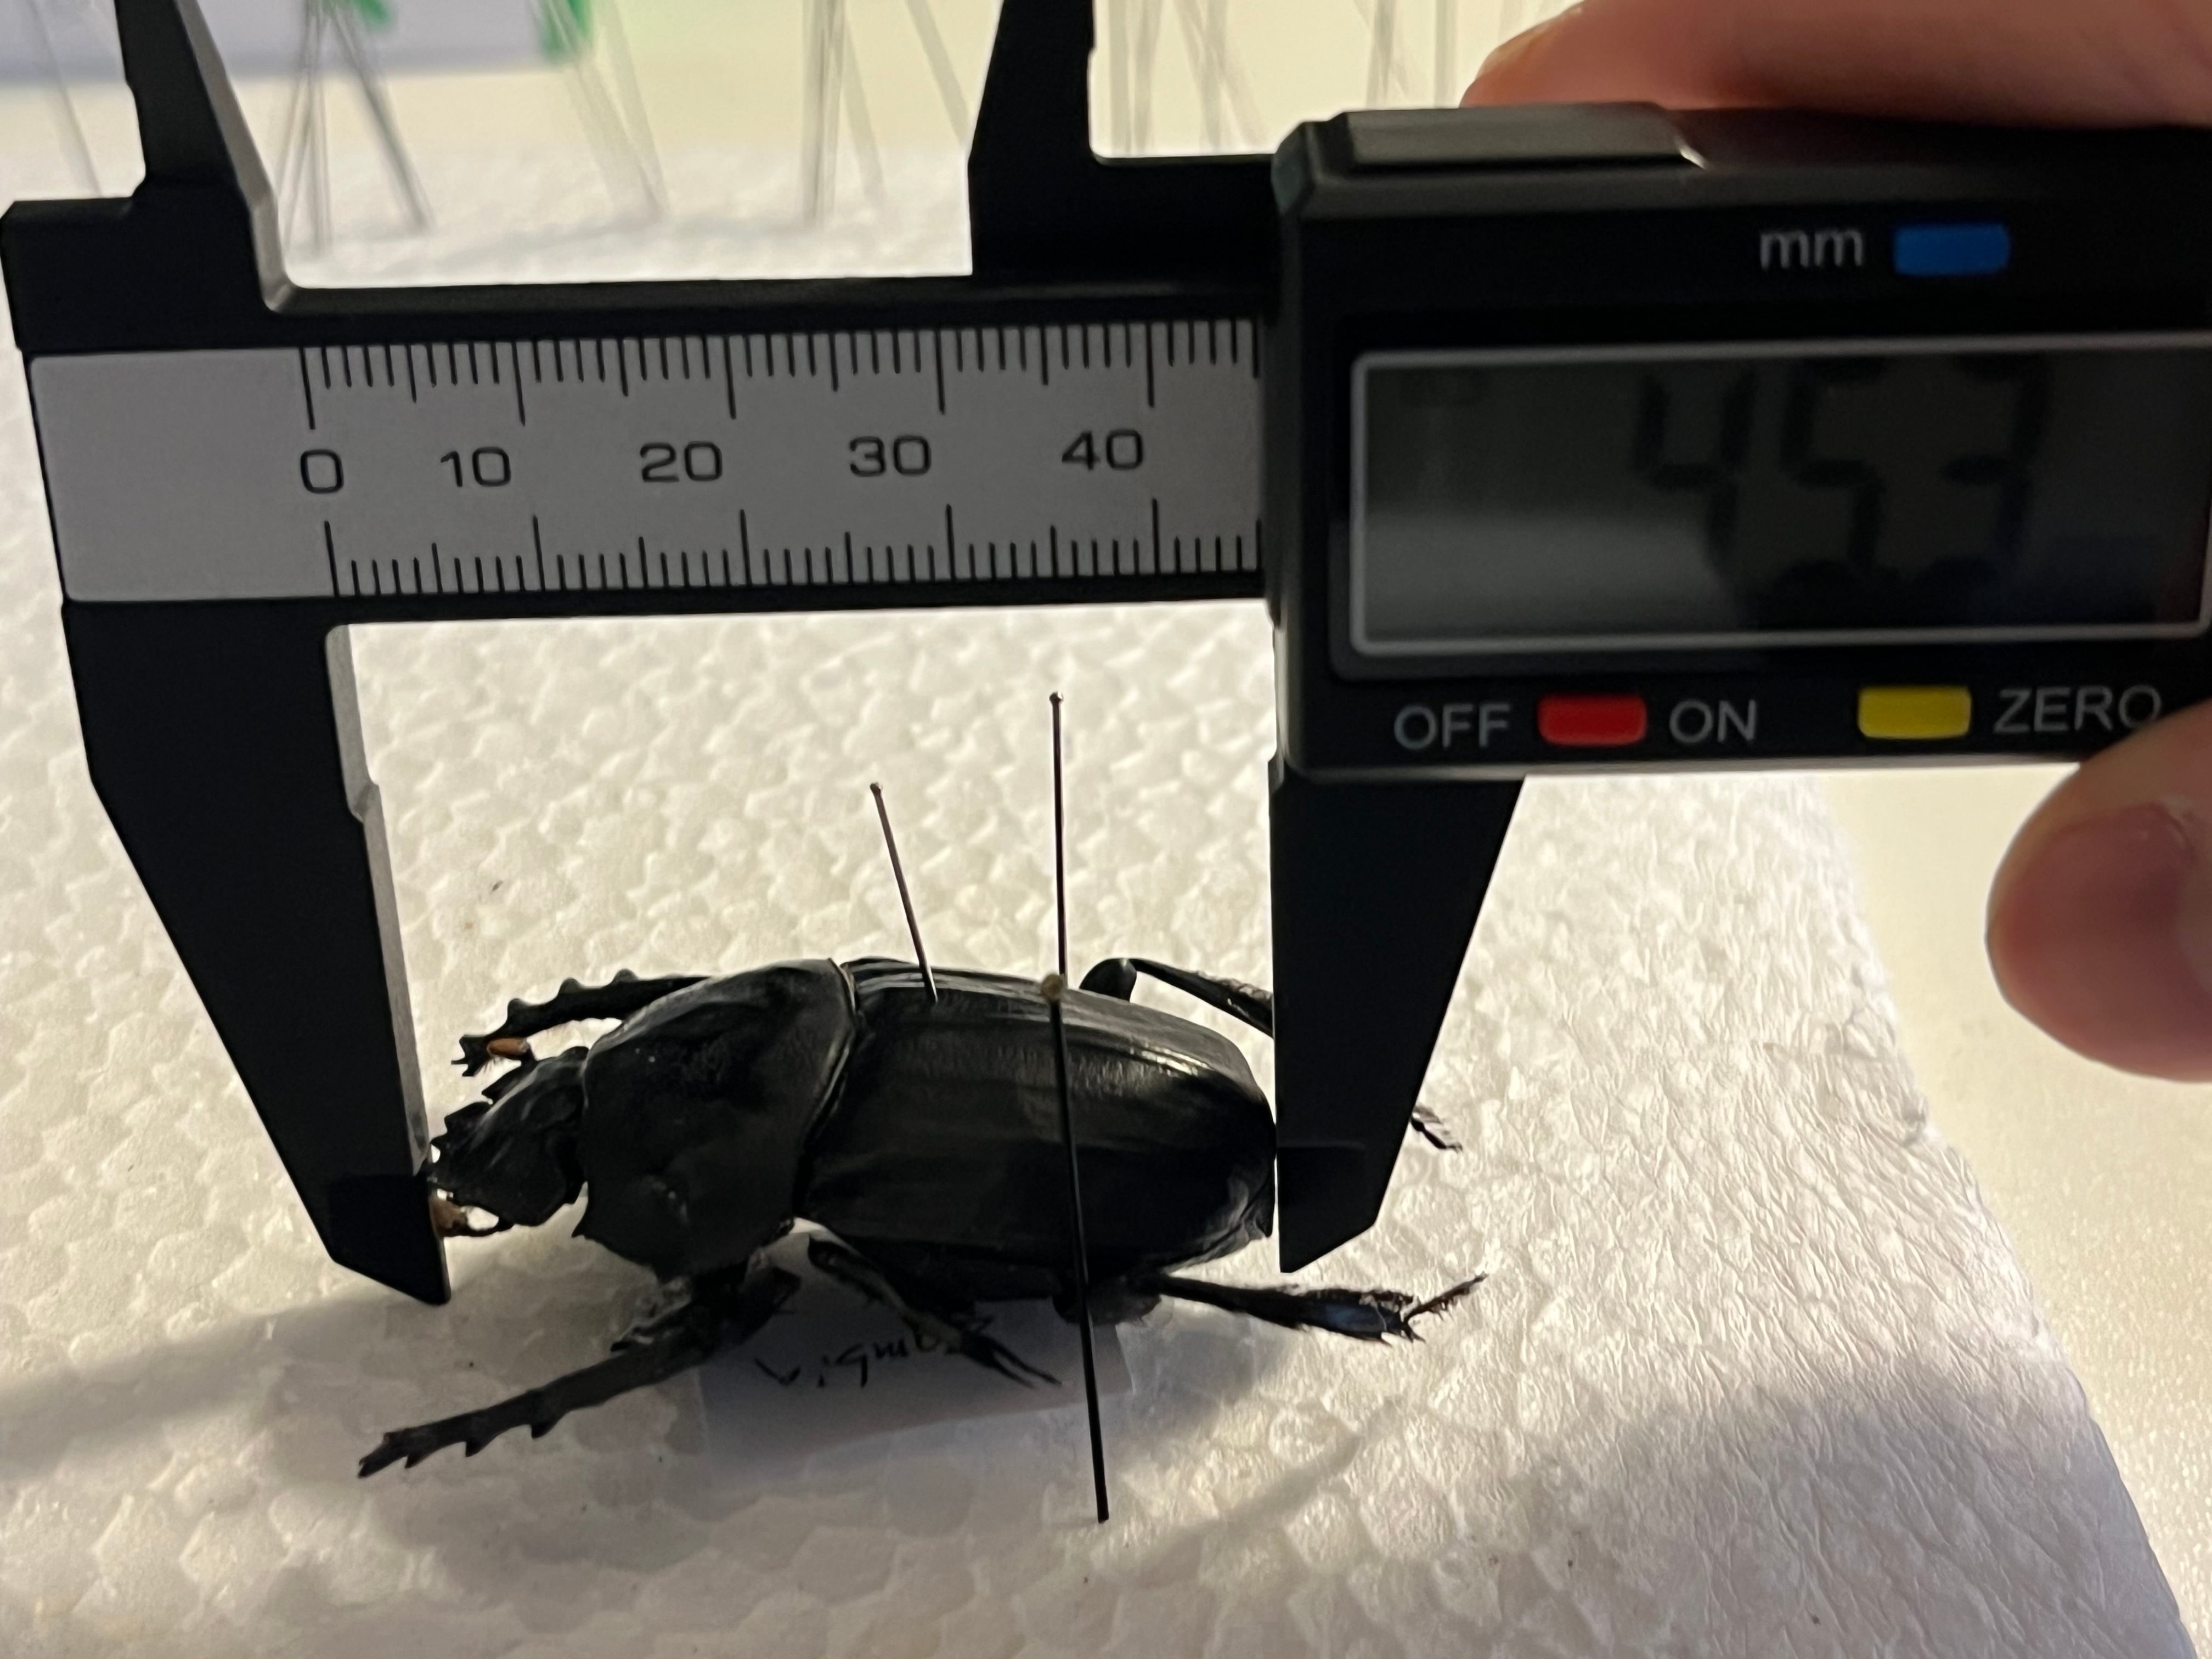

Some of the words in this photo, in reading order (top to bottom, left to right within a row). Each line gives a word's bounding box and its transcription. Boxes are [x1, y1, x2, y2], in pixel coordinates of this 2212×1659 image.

[1759, 230, 1863, 269] mm
[300, 449, 345, 494] 0
[441, 446, 512, 488] 10
[640, 441, 723, 482] 20
[849, 436, 932, 477] 30
[1061, 428, 1144, 471] 40
[1393, 703, 1511, 750] OFF
[1668, 699, 1756, 743] ON
[1993, 684, 2162, 734] ZERO
